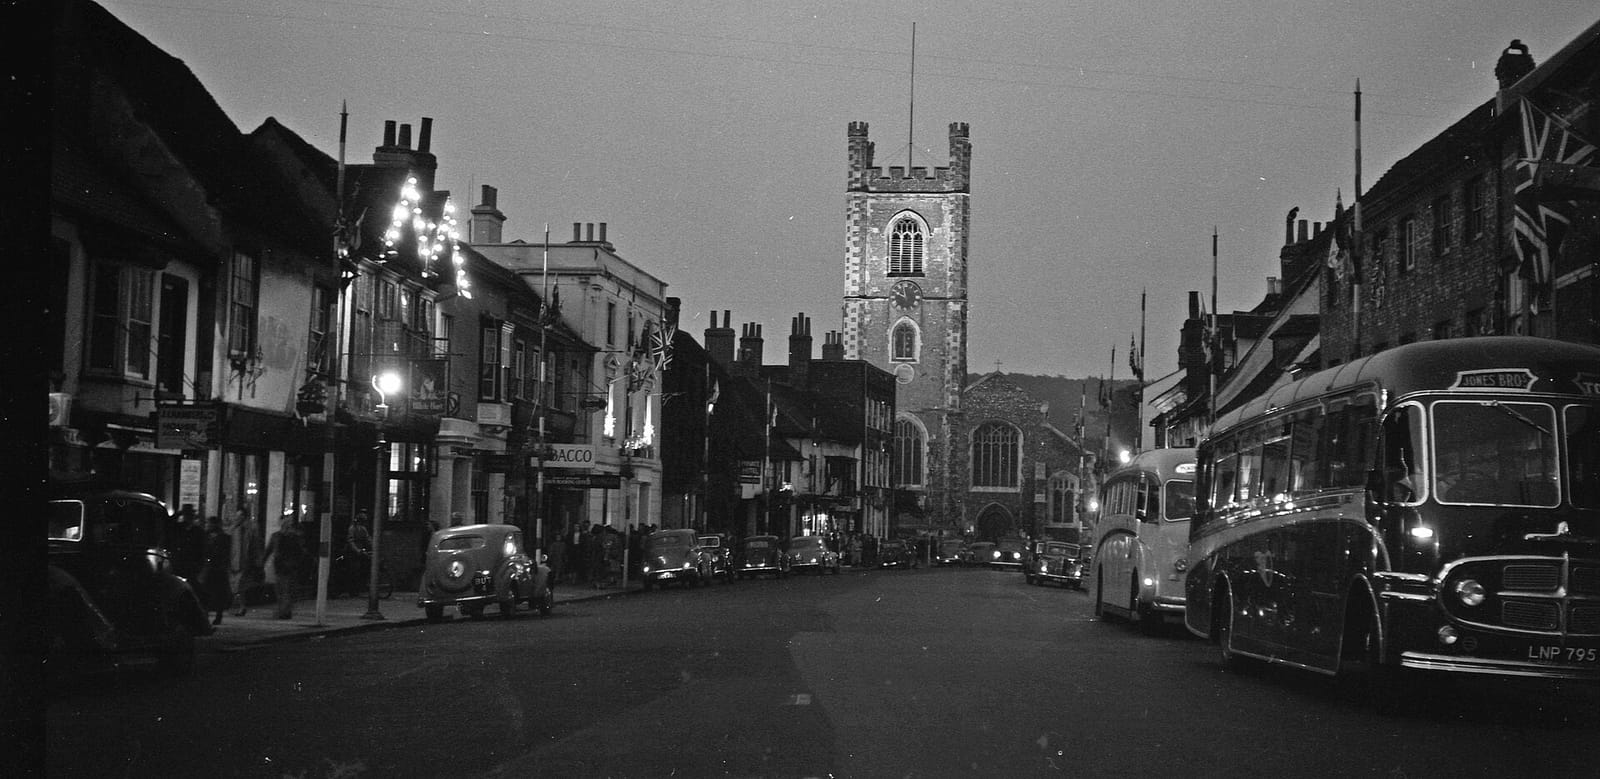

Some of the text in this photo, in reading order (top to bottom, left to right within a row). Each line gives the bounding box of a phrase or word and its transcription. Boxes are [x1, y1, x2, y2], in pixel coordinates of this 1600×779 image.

[1463, 375, 1496, 387] JONES
[1528, 645, 1597, 662] LNP 795
